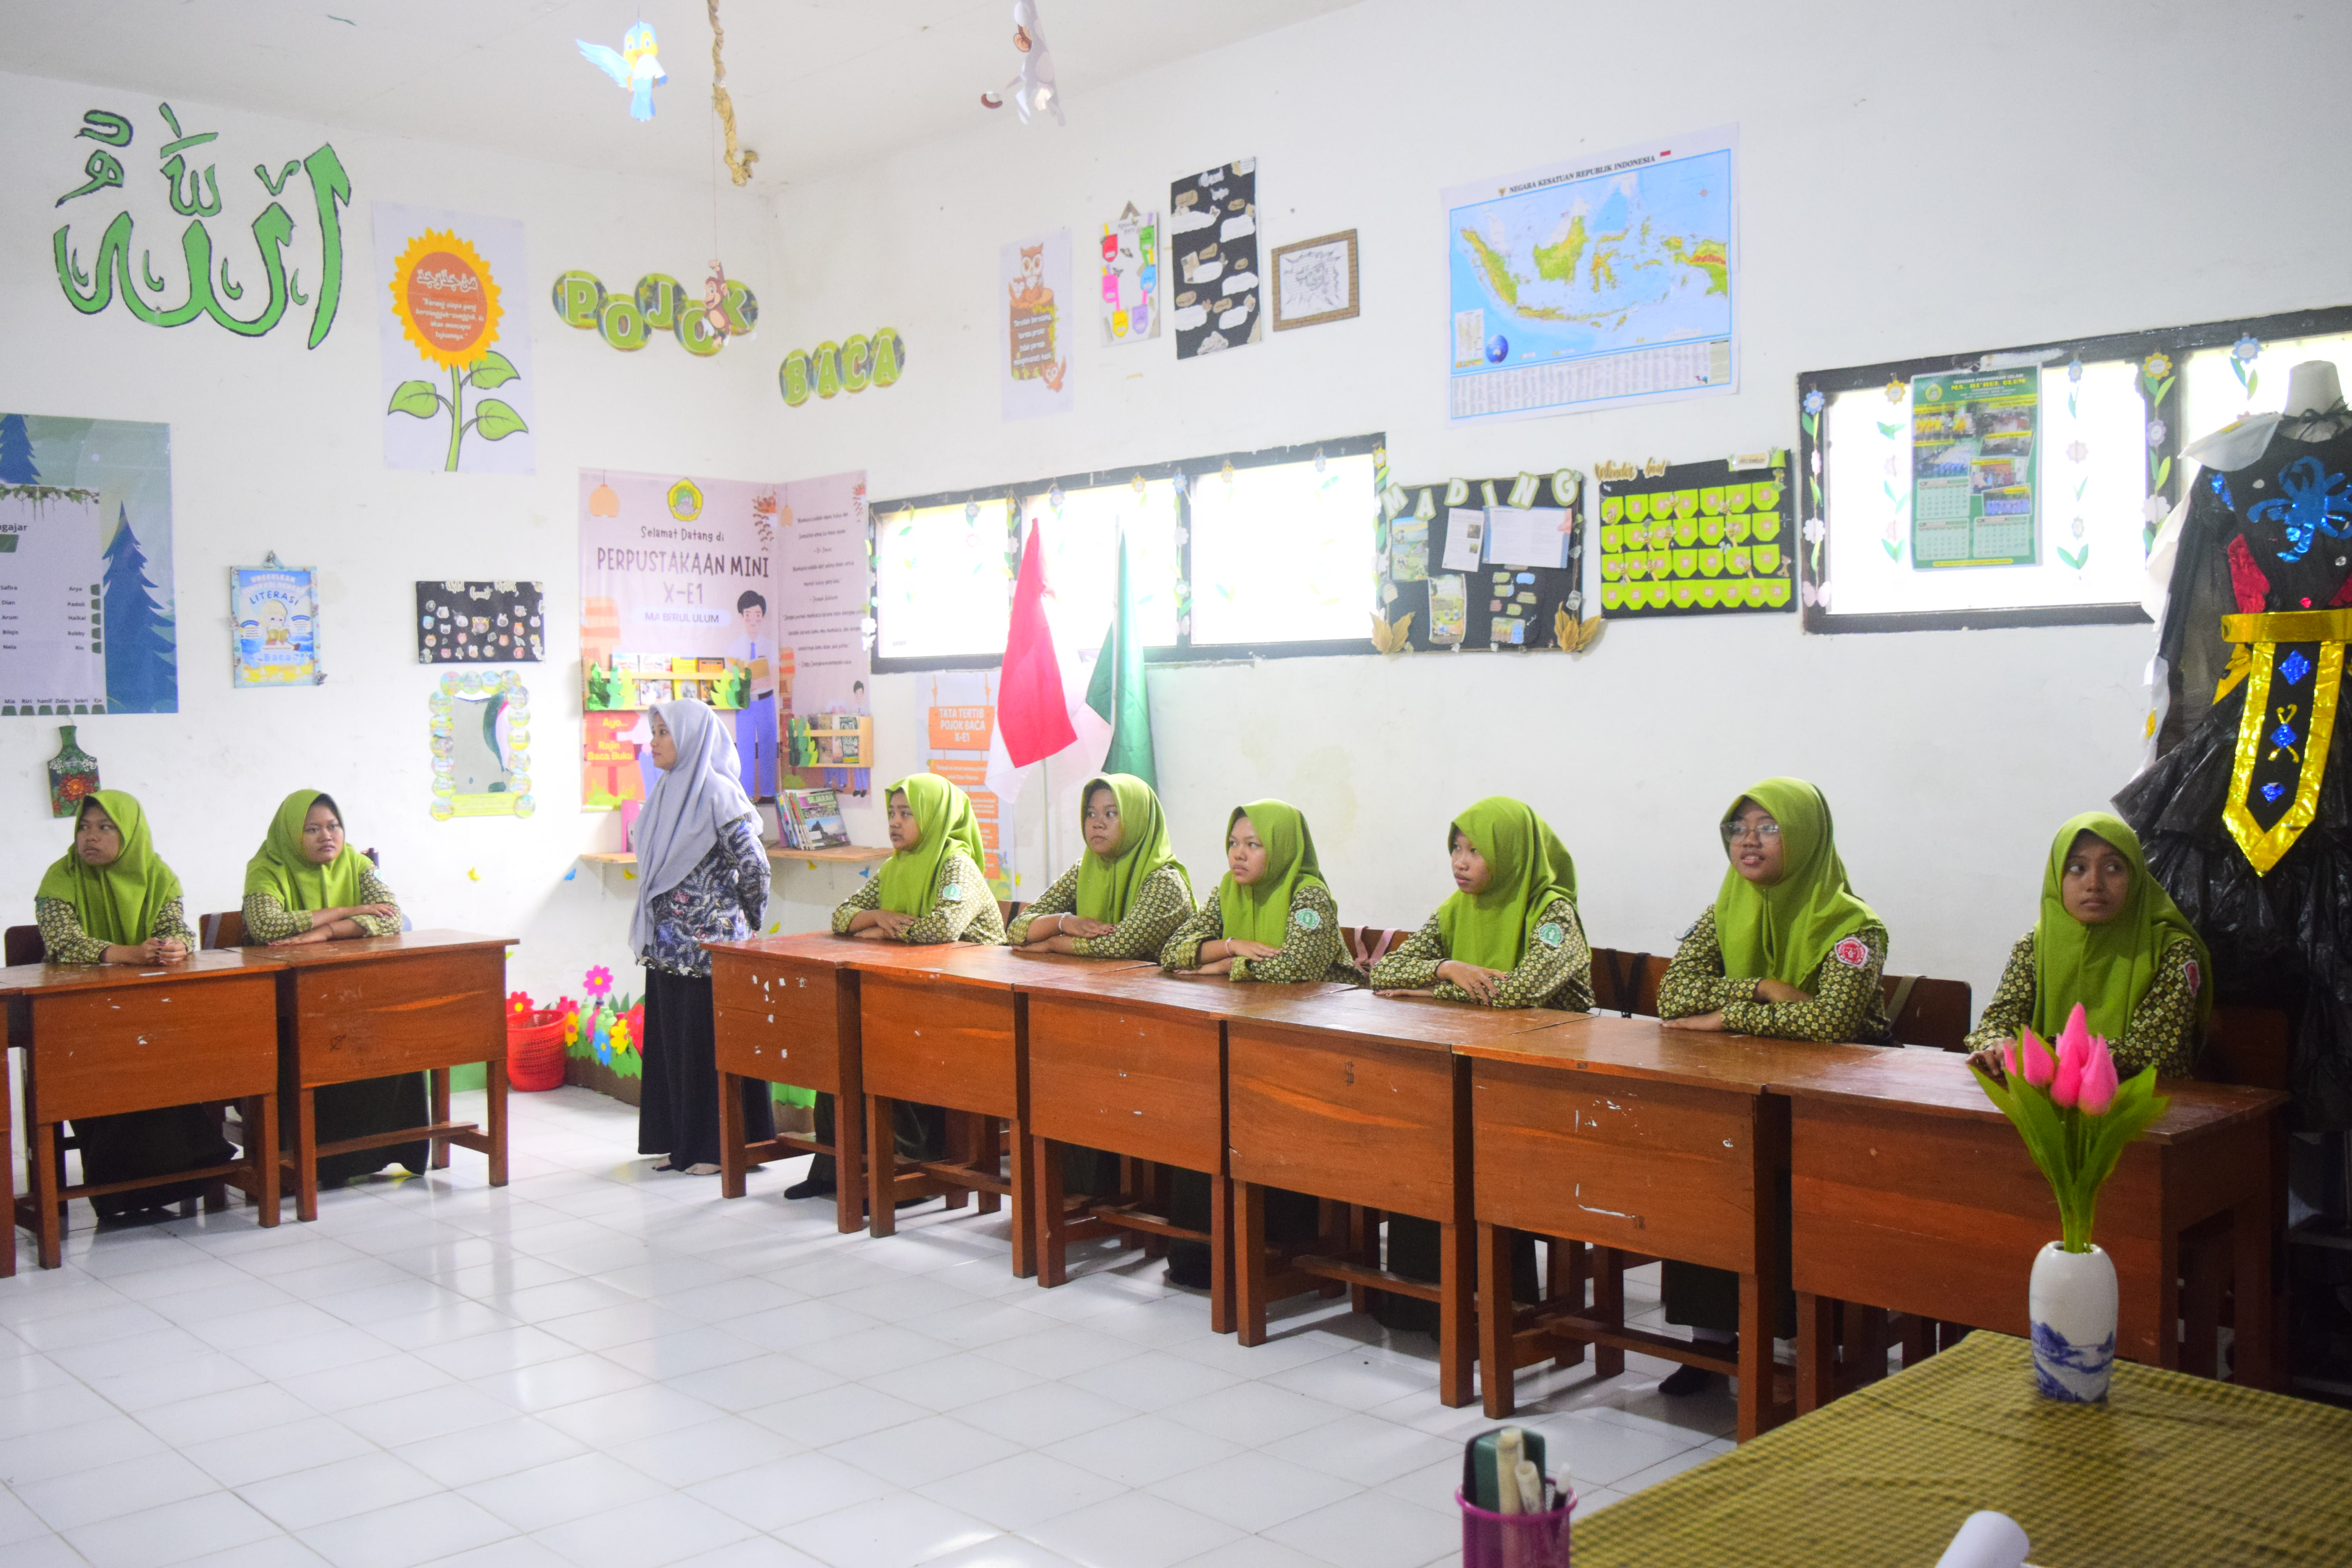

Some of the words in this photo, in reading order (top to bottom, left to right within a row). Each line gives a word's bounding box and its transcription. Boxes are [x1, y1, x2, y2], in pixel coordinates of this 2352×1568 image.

[1509, 182, 1536, 193] NEGARA
[1538, 173, 1574, 187] KESATUAN
[1576, 165, 1612, 178] REPUBLIK
[1614, 156, 1655, 169] INDONESIA
[786, 336, 898, 406] BACA
[1379, 468, 1579, 520] MADING
[641, 526, 678, 539] Selamat
[681, 528, 713, 543] Datang
[716, 531, 724, 541] di
[597, 547, 724, 576] PERPUSTAKAAN
[731, 555, 768, 578] MINI
[249, 590, 299, 605] LITERASI
[663, 581, 702, 604] X-E1
[645, 612, 660, 621] MA
[693, 614, 719, 623] ULUM
[939, 708, 957, 718] TATA
[958, 708, 984, 718] TERTIB
[940, 720, 963, 730] POJOK
[965, 720, 985, 731] BACA
[955, 732, 970, 742] X-E1
[599, 741, 620, 751] Rajin
[588, 752, 610, 760] Baca
[612, 751, 633, 760] Buku
[808, 795, 834, 804] SEJARAH
